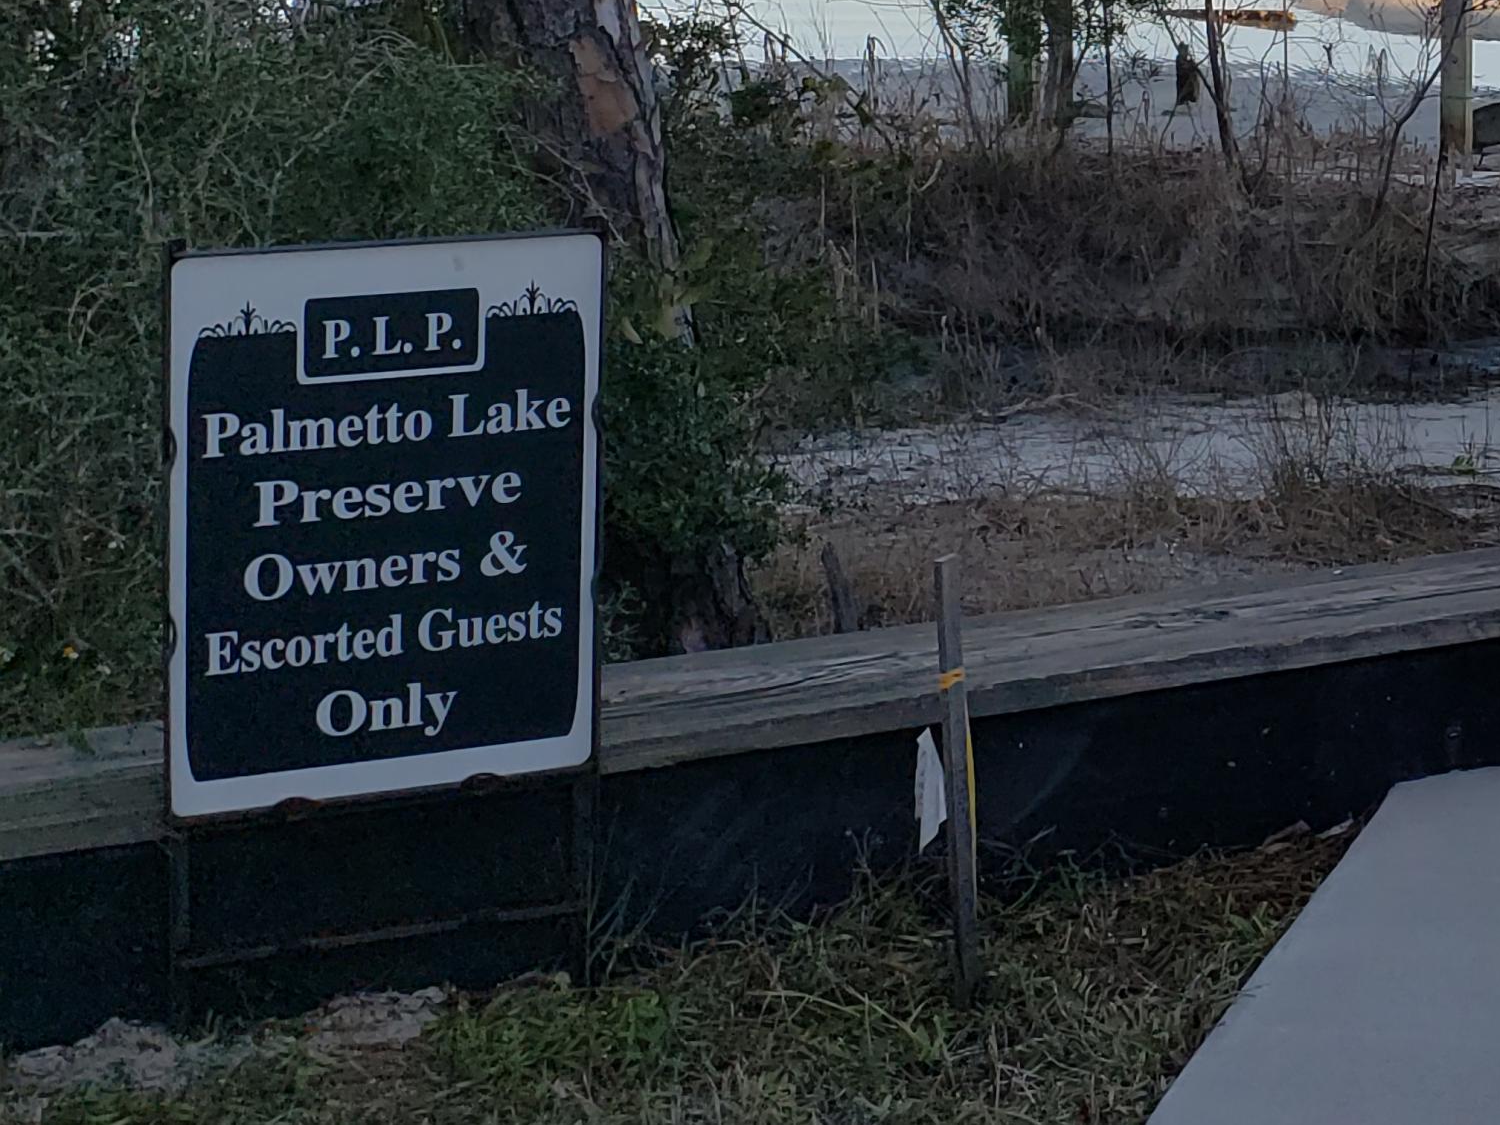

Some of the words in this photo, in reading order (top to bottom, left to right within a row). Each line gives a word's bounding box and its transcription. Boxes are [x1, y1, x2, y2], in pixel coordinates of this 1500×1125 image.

[201, 402, 432, 459] Palmetto
[448, 389, 571, 440] Lake
[252, 472, 522, 528] Preserve
[243, 546, 461, 602] Owners
[480, 531, 528, 577] &
[204, 614, 402, 676] Escorted
[418, 601, 563, 652] Guests
[315, 683, 458, 737] Only
